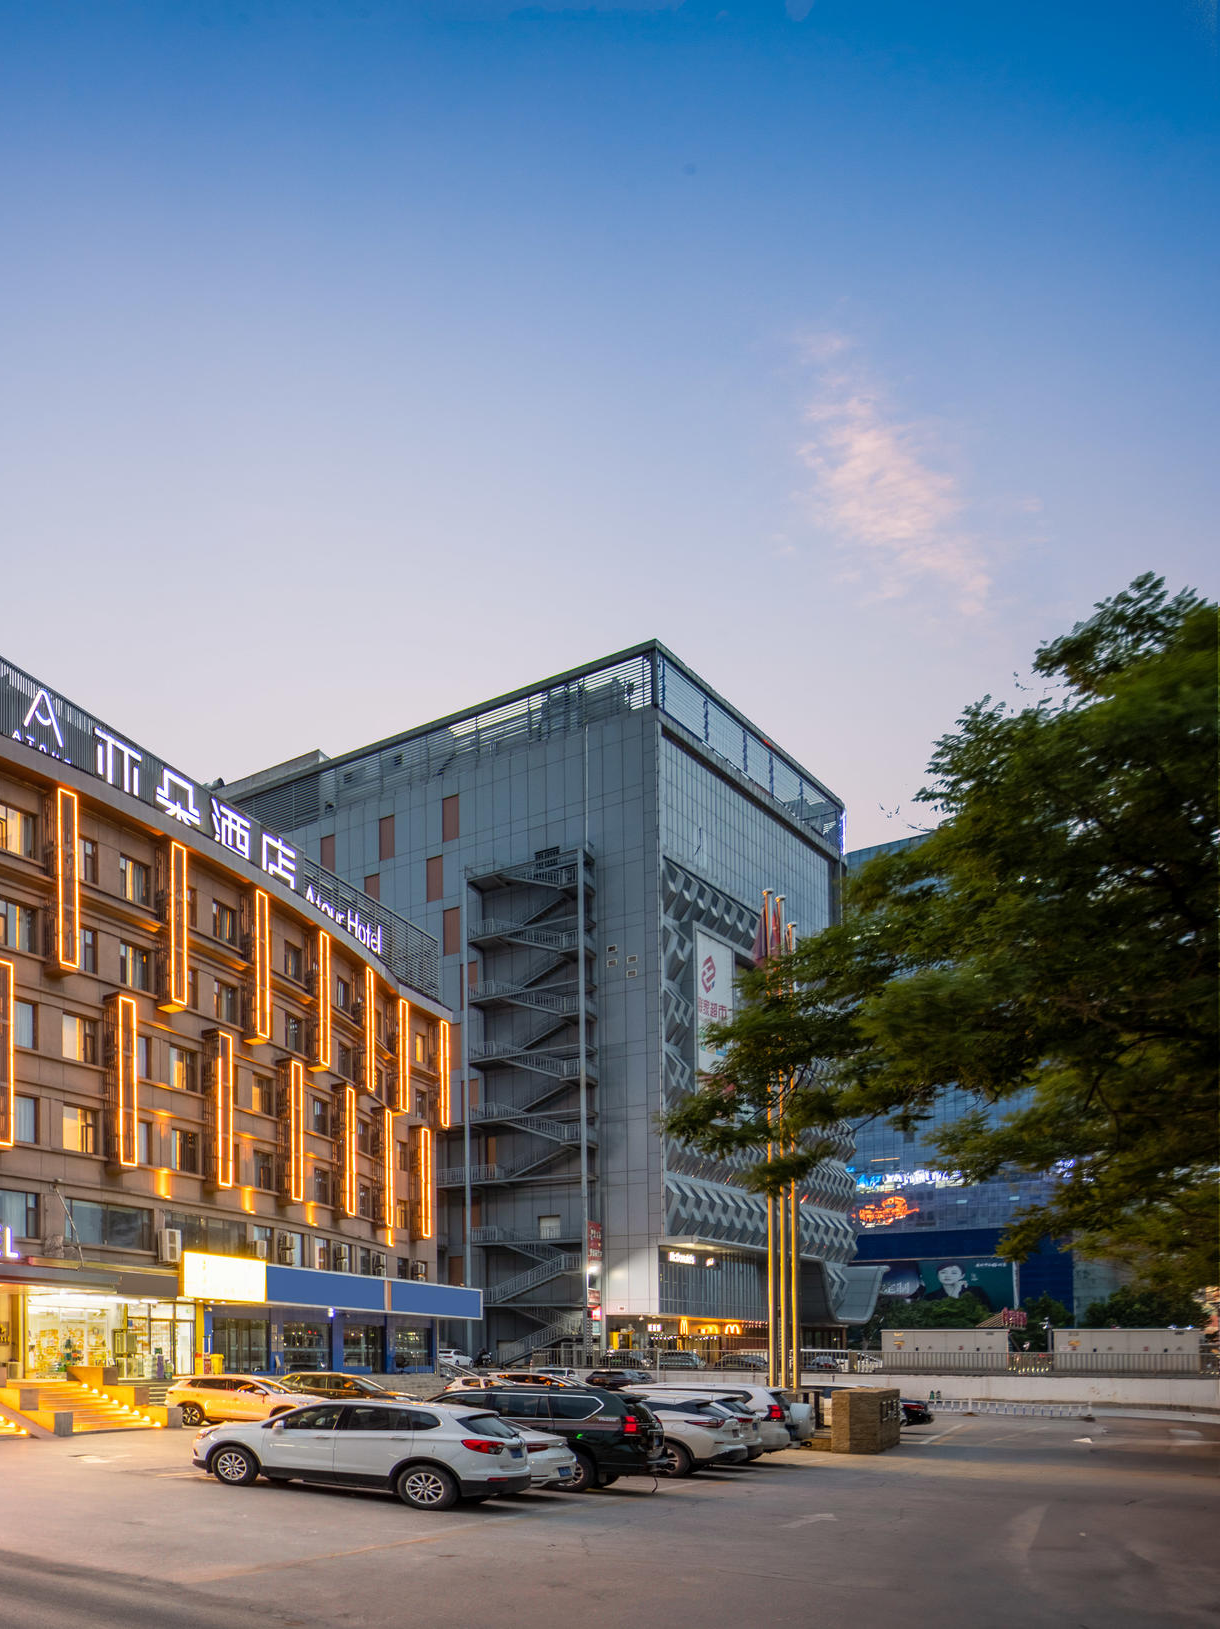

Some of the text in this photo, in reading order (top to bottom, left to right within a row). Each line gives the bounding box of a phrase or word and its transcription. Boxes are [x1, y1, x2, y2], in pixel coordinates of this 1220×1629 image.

[94, 726, 297, 890] 亚朵酒店
[347, 908, 382, 955] Hotel
